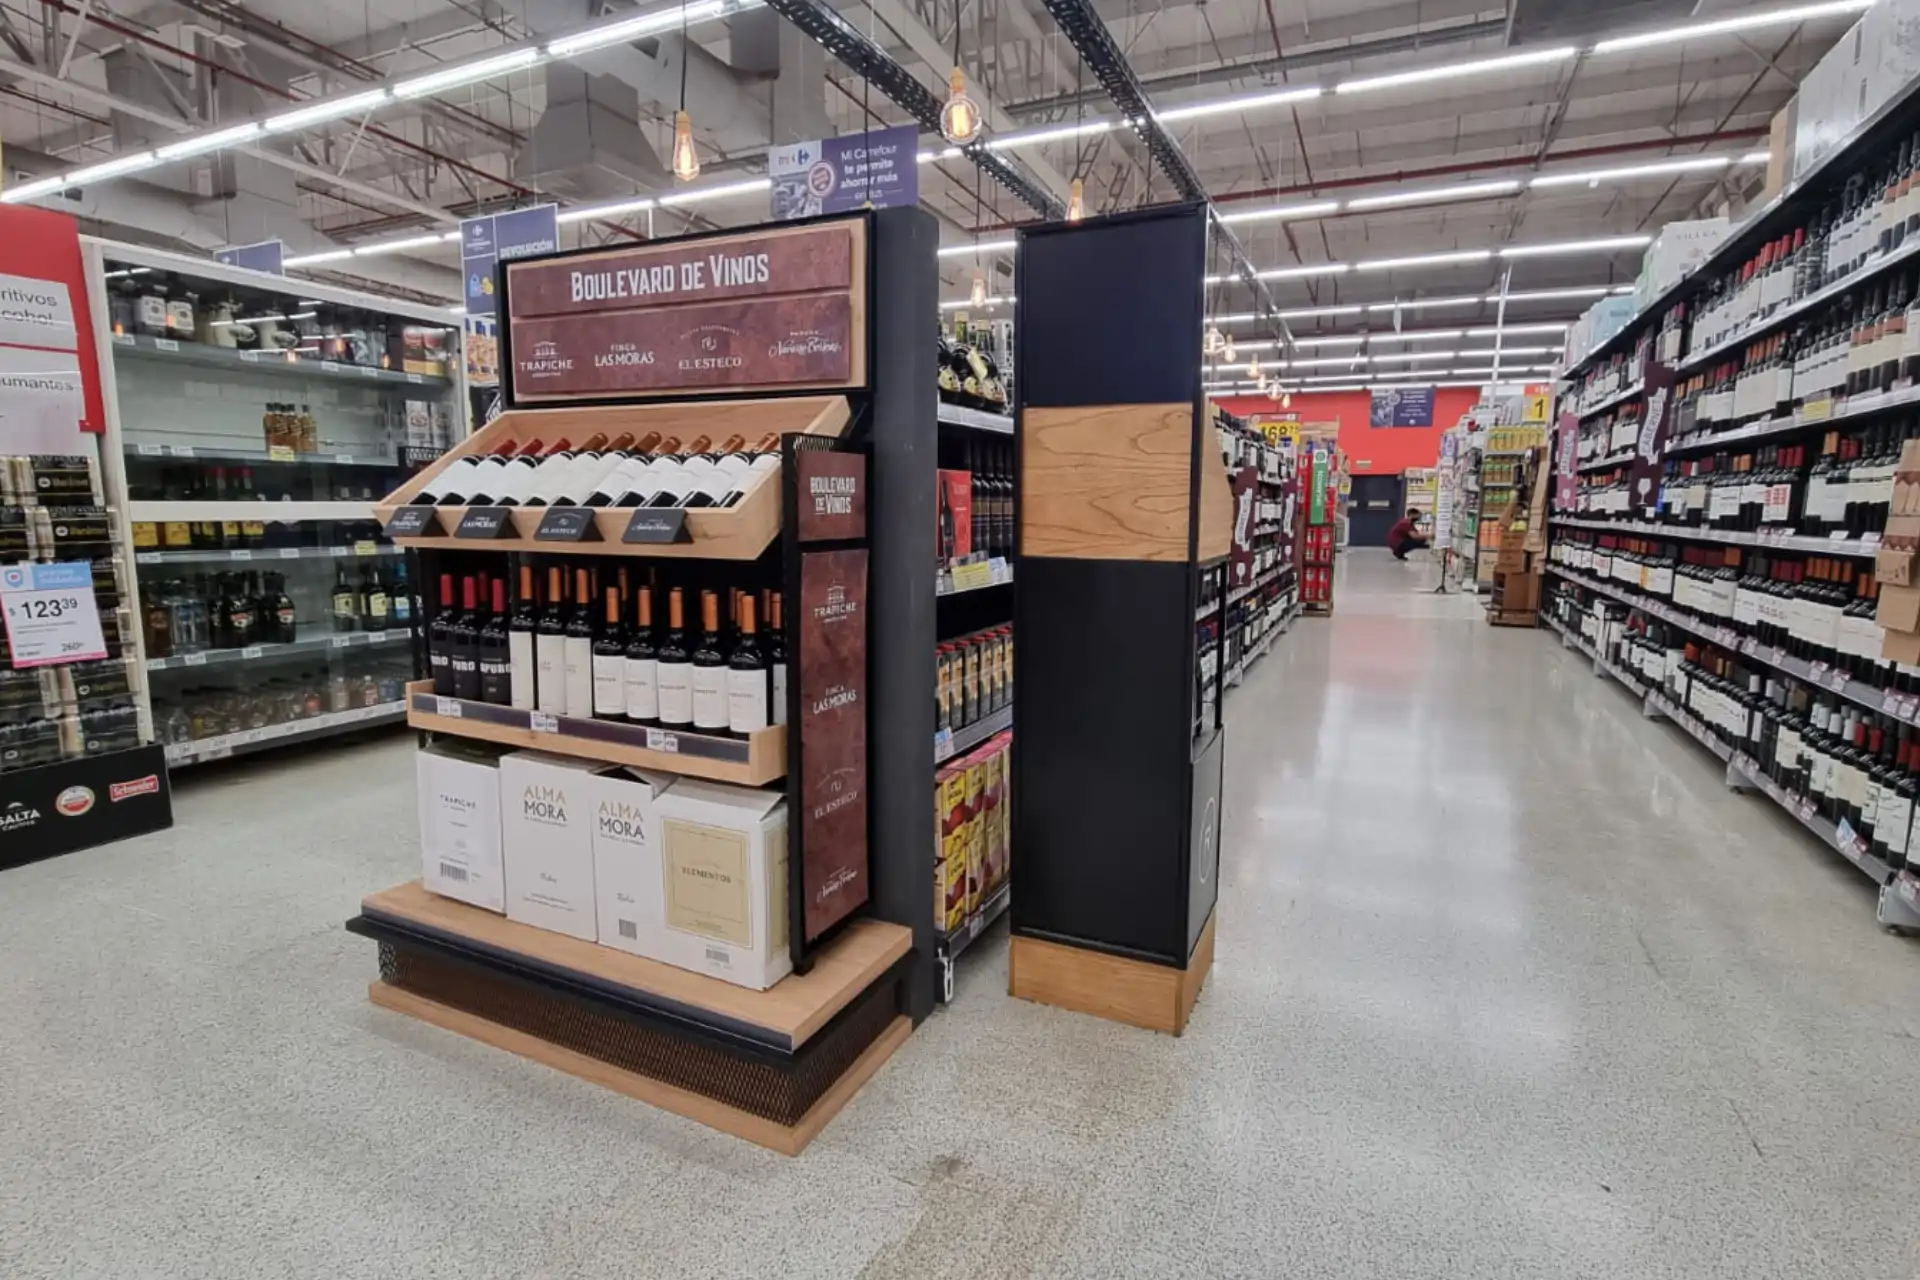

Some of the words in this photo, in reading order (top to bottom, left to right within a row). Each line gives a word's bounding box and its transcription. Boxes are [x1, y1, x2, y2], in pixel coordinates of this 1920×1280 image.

[854, 145, 898, 160] Carefour
[519, 359, 573, 372] TRAPICHE
[594, 353, 624, 367] LAS
[624, 350, 655, 366] MORAS
[695, 356, 742, 369] ESTECO
[810, 476, 856, 493] BOULEVARD
[825, 493, 852, 514] VINOS
[814, 601, 857, 618] TRAPICHE
[523, 785, 567, 804] ALMA
[0, 807, 41, 827] SALTA
[524, 799, 568, 822] MORA
[598, 800, 644, 823] ALMA
[599, 816, 646, 840] MORA
